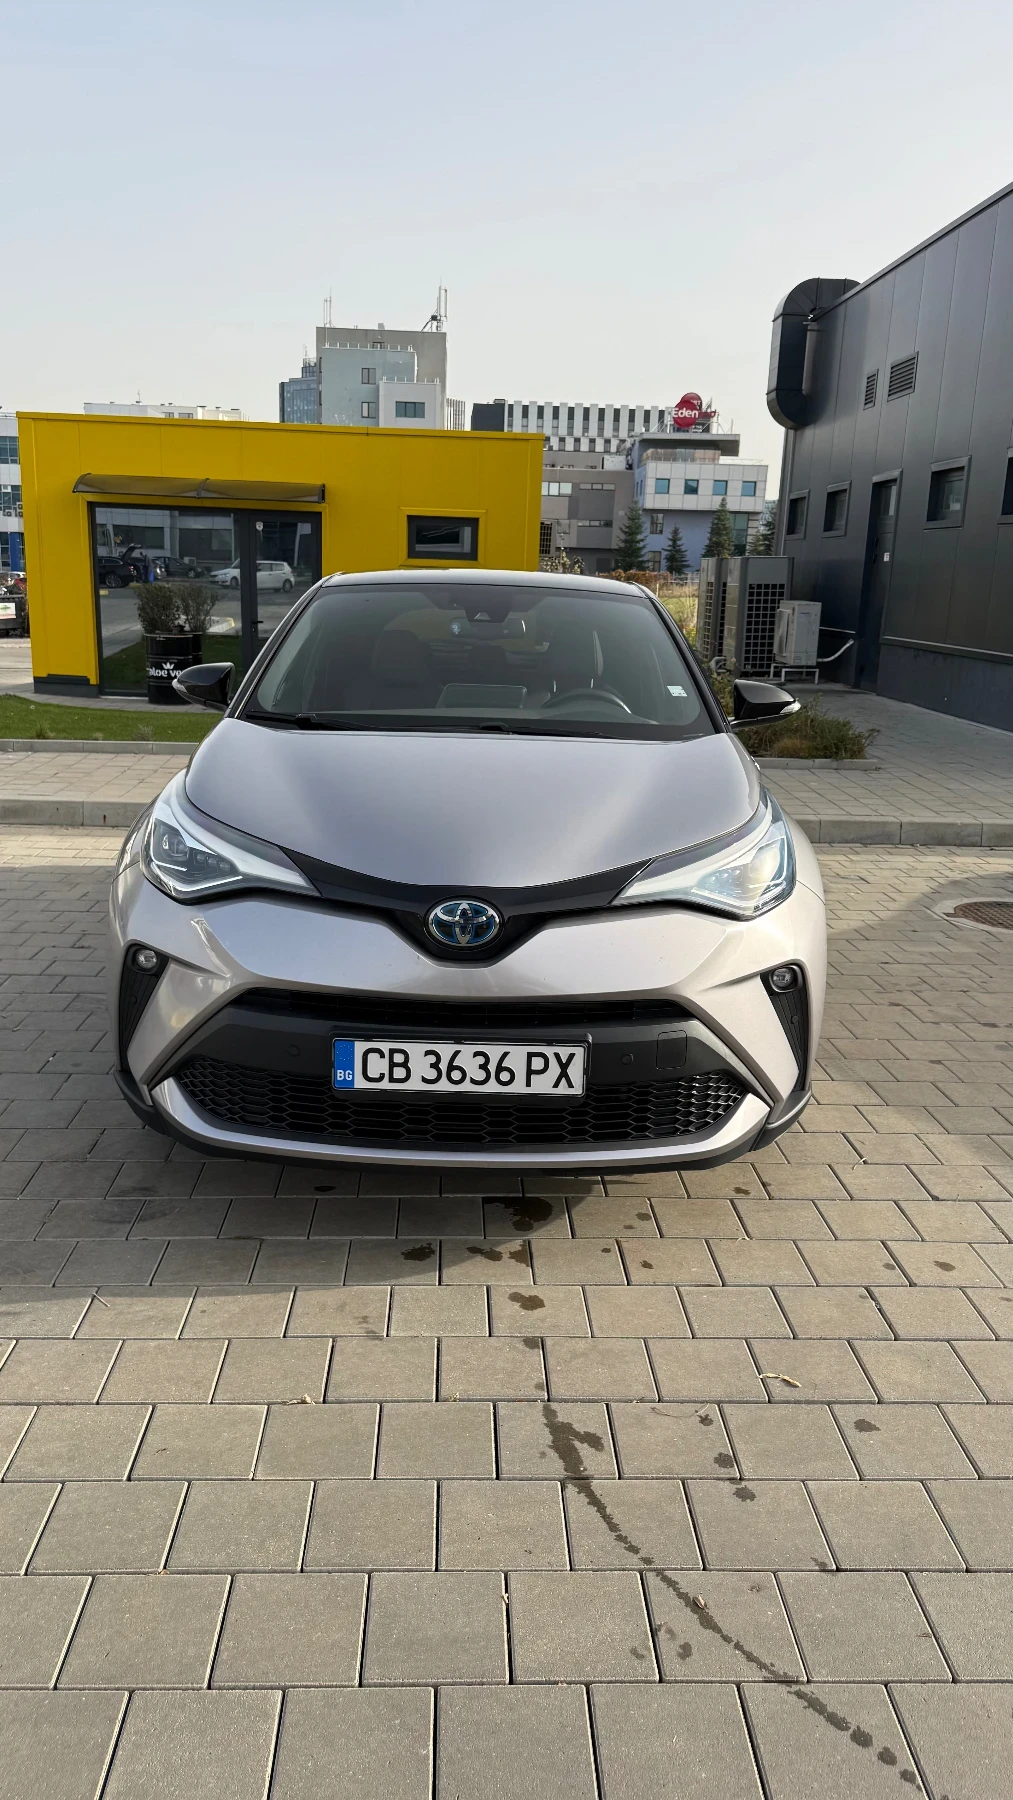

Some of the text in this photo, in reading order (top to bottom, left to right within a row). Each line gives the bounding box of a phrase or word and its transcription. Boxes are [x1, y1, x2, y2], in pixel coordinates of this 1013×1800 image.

[336, 1069, 353, 1081] BG
[361, 1047, 576, 1088] CB 3636 PX
